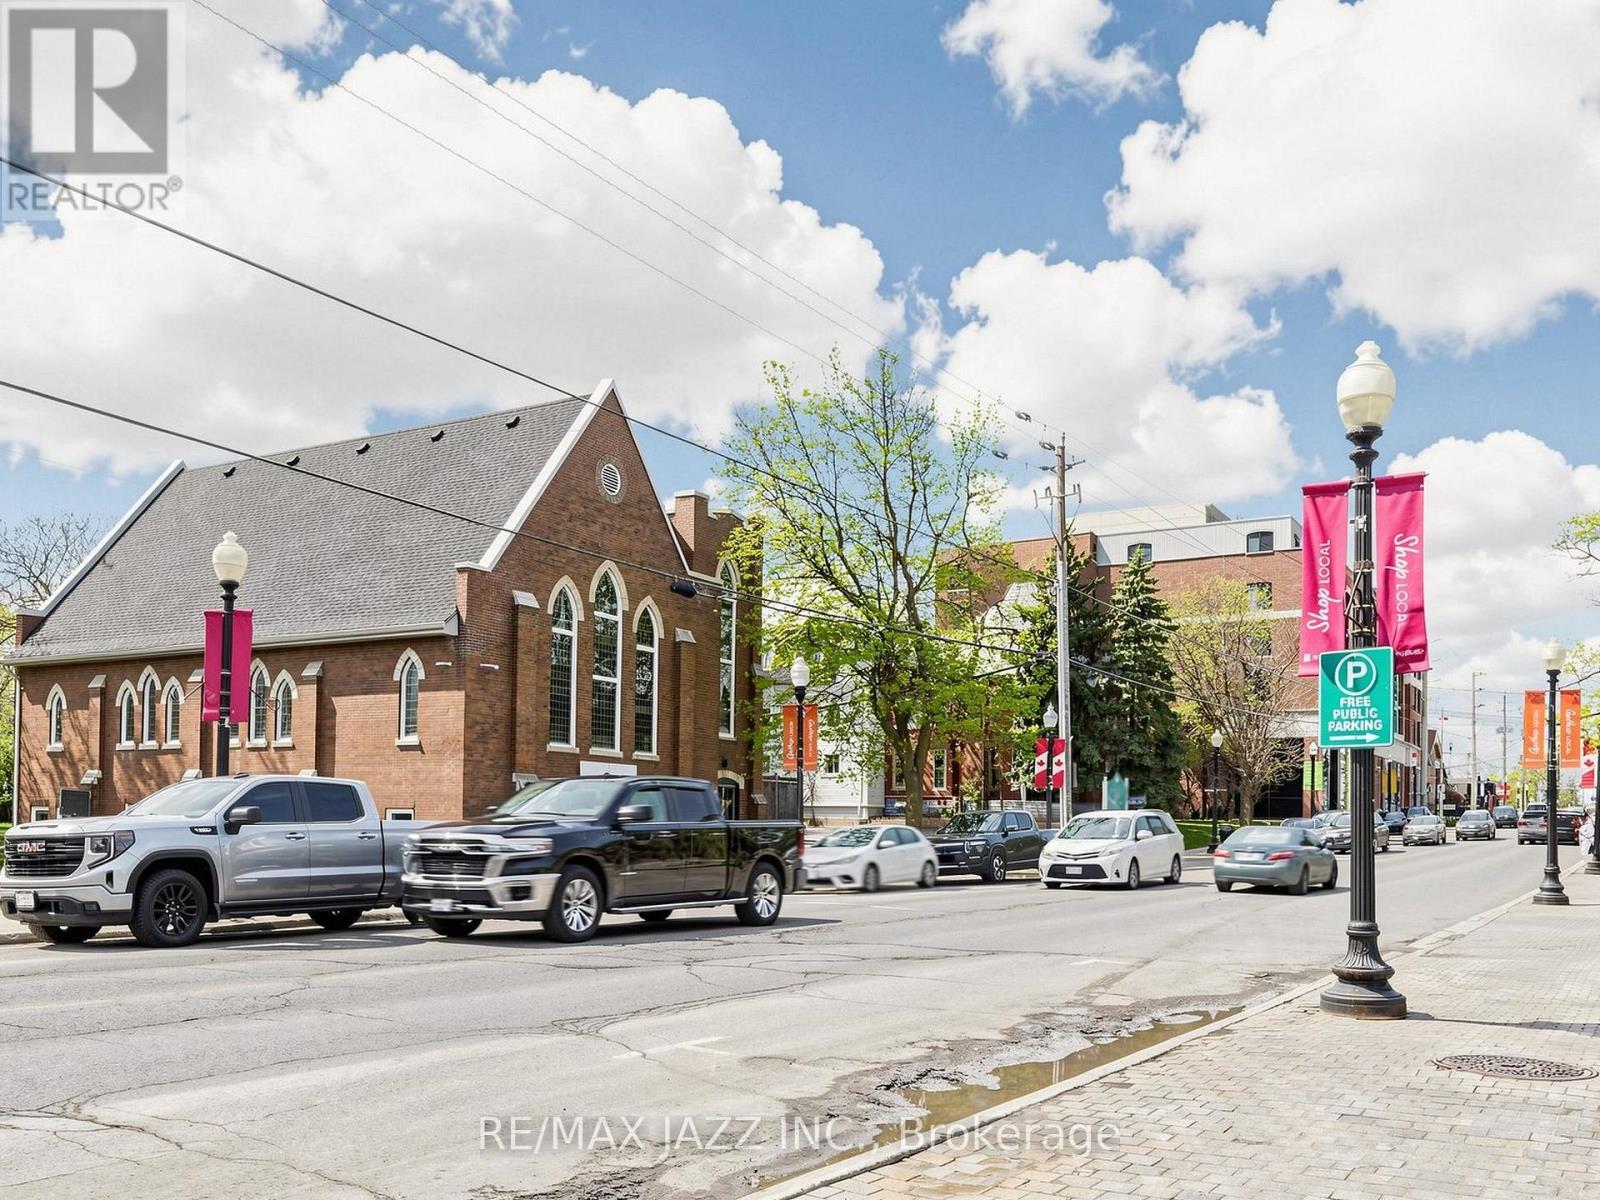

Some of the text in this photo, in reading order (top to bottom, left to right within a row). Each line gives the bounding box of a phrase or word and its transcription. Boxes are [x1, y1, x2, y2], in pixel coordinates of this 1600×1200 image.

[1384, 533, 1420, 580] Shop
[1306, 587, 1342, 633] Shop
[1347, 661, 1368, 688] P
[1339, 696, 1371, 708] FREE
[1332, 707, 1378, 720] PUBLIC
[1327, 719, 1383, 732] PARKING
[16, 841, 46, 852] GMC
